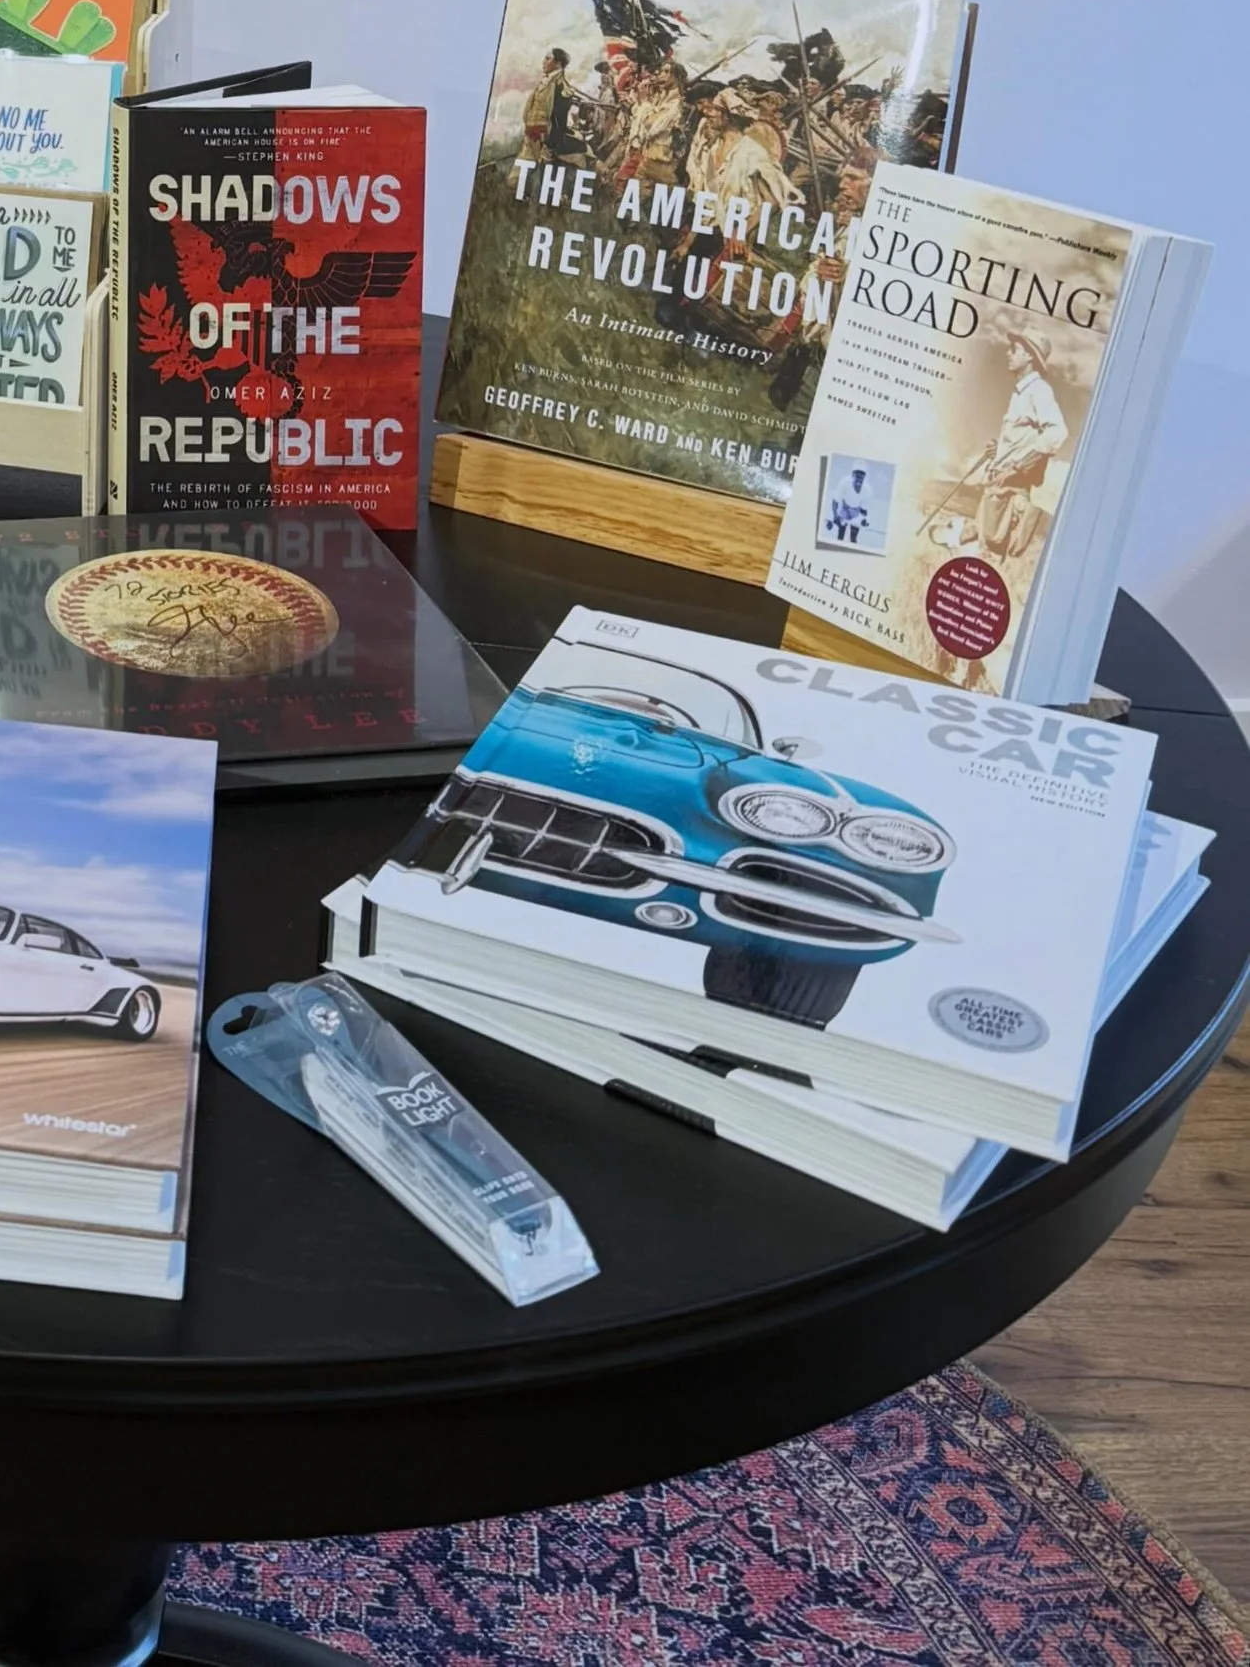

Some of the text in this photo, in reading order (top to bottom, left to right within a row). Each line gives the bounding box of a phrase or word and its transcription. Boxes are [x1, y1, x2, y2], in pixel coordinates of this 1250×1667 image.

[23, 108, 49, 131] ME
[200, 127, 231, 135] ALARM
[234, 127, 258, 135] BELL
[262, 127, 323, 135] ANNOUNCING
[328, 126, 351, 135] THAT
[355, 126, 372, 135] THE
[296, 152, 325, 161] KING
[149, 174, 402, 224] SHADOWS
[514, 159, 596, 212] THE
[877, 199, 912, 223] THE
[54, 226, 76, 245] TO
[52, 248, 77, 267] ME
[528, 226, 835, 325] REVOLUTION
[862, 225, 1102, 330] SPORTING
[1, 277, 82, 309] in all
[852, 268, 979, 339] ROAD
[189, 302, 361, 355] OF THE
[564, 307, 774, 365] An Intimate History
[210, 386, 332, 400] OMER AZIZ
[514, 362, 536, 375] KEN
[580, 376, 618, 392] SARAH
[682, 399, 709, 413] AND
[712, 405, 748, 422] DAVID
[581, 354, 741, 397] BASED ON THE FILM SERIES BY
[139, 416, 404, 466] REPUBLIC
[485, 385, 579, 423] GEOFFREY
[586, 409, 604, 430] C.
[615, 415, 669, 445] WARD
[676, 435, 703, 452] AND
[710, 438, 751, 464] KEN
[150, 483, 392, 494] THE REBIRTH OF FASCISM IN AMERICA
[782, 551, 892, 613] JIM FERGUS
[778, 577, 826, 605] Introduction
[842, 607, 873, 628] RICK
[877, 622, 905, 643] BASS
[303, 709, 429, 731] LEE
[756, 658, 1123, 757] CLASSIC
[927, 724, 1117, 788] CAR
[958, 766, 1108, 808] VISUAL HISTORY
[970, 761, 1109, 799] THE DEFINITIVE
[1030, 795, 1106, 818] NEW EDITION
[388, 1081, 446, 1111] BOOK
[400, 1096, 458, 1126] LIGHT
